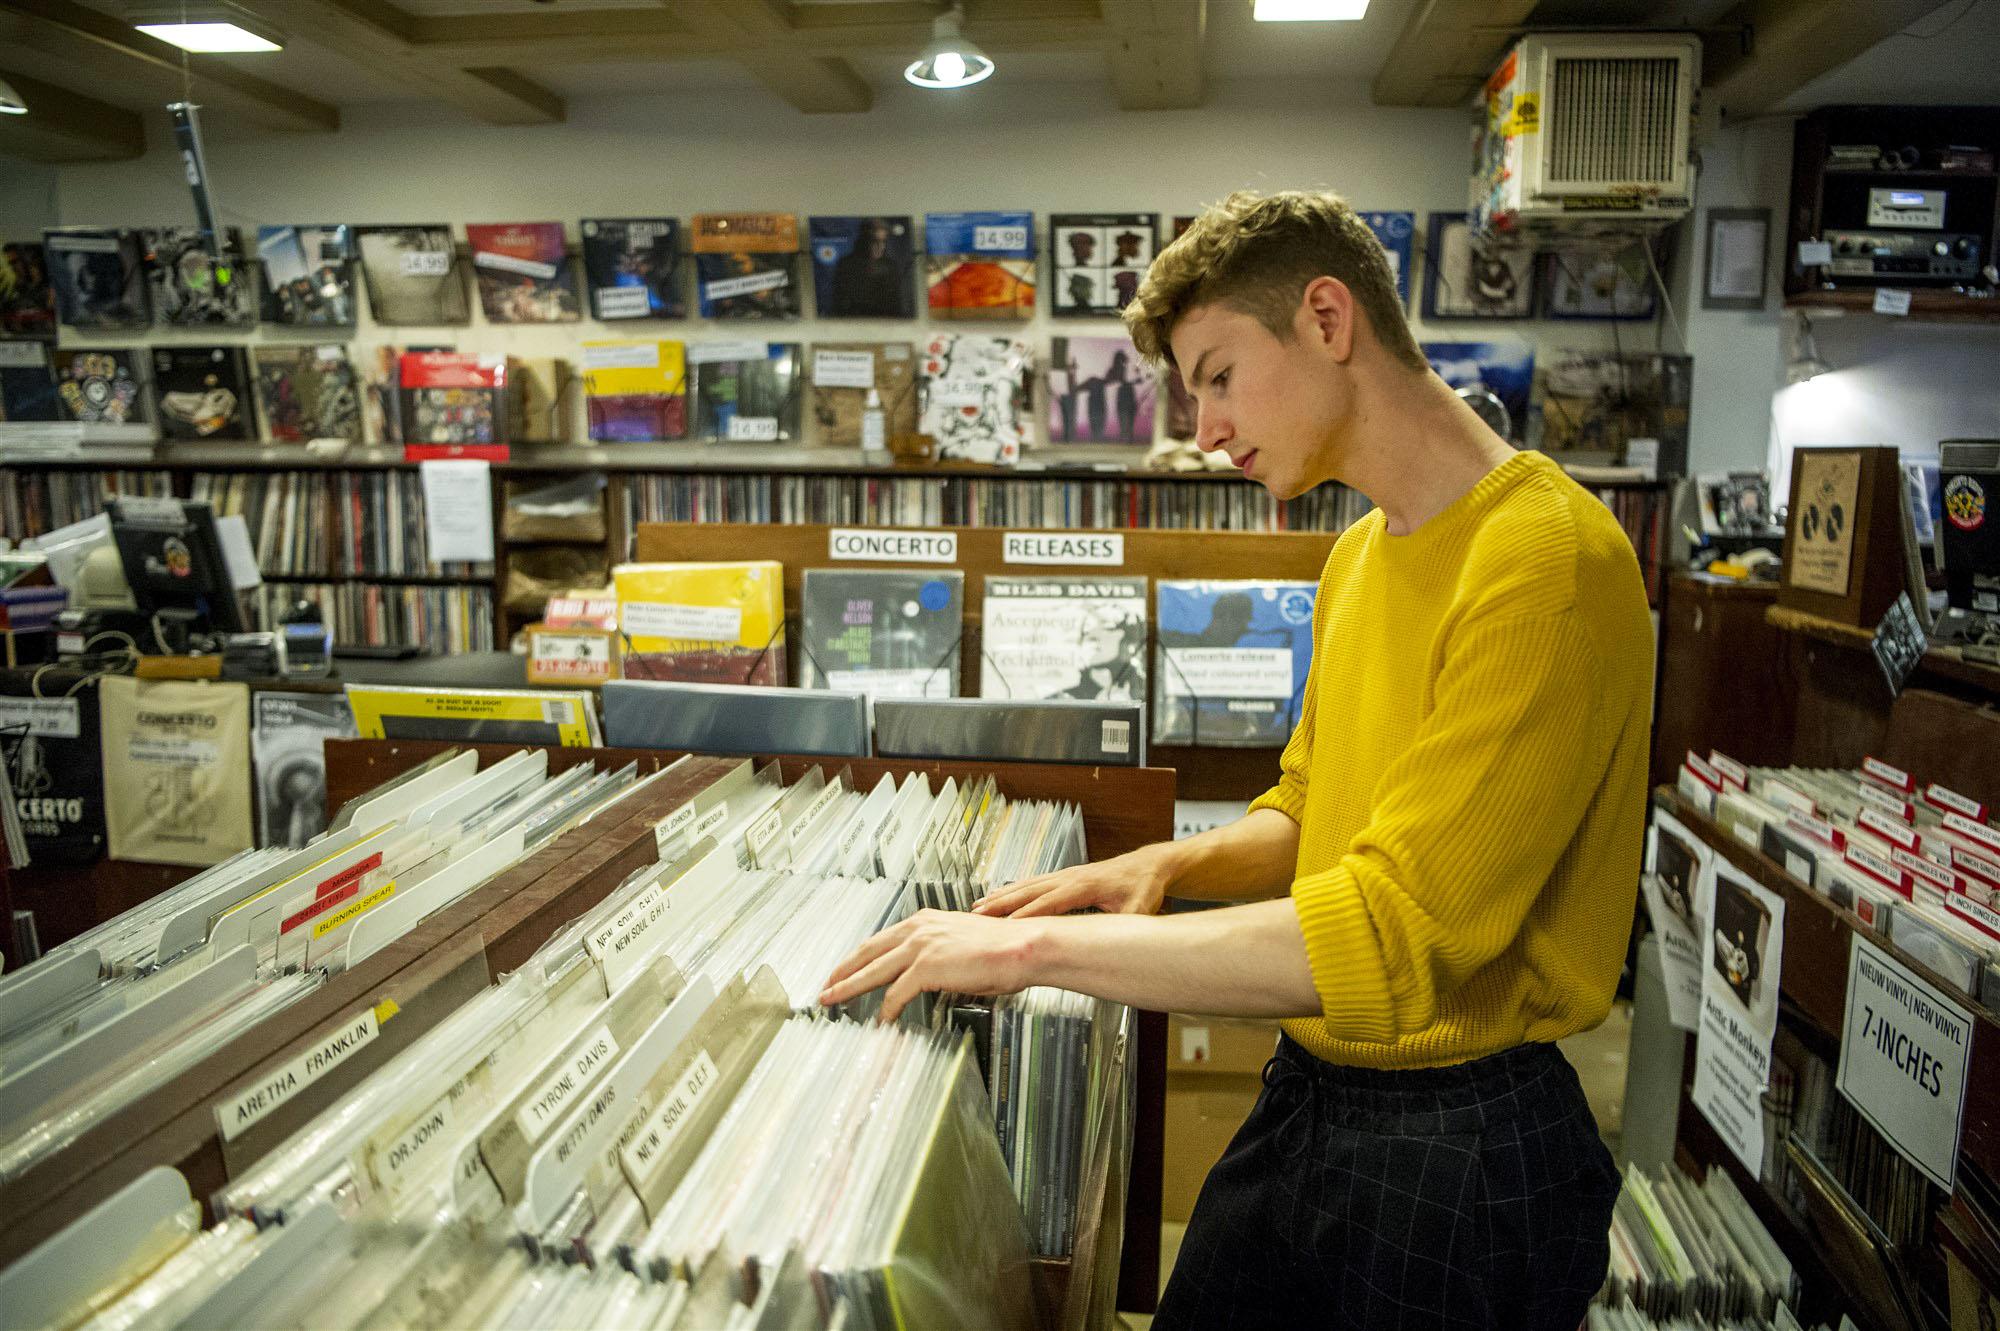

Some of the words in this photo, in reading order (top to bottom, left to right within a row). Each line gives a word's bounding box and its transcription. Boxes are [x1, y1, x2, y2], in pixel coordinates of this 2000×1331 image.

[835, 535, 953, 557] CONCERTO
[1009, 538, 1113, 558] RELEASES
[992, 583, 1063, 597] MILES
[1068, 583, 1136, 597] DAVIS
[319, 903, 361, 933] BURNING
[362, 886, 392, 907] SPEAR
[614, 932, 631, 954] NEW
[631, 917, 649, 940] SOUL
[1859, 959, 1886, 989] NIEUW
[1886, 977, 1909, 1008] VINYL
[1914, 997, 1934, 1025] NEW
[1935, 1011, 1962, 1046] VINYL
[237, 1071, 297, 1125] ARETHA
[306, 1021, 369, 1075] FRANKLIN
[532, 1073, 577, 1121] TYRONE
[577, 1038, 609, 1077] DAVIS
[1862, 1004, 1944, 1098] 7-INCHES
[556, 1118, 589, 1164] BETTY
[589, 1084, 617, 1126] DAVIS
[636, 1130, 661, 1165] NEW
[663, 1096, 688, 1131] SOUL
